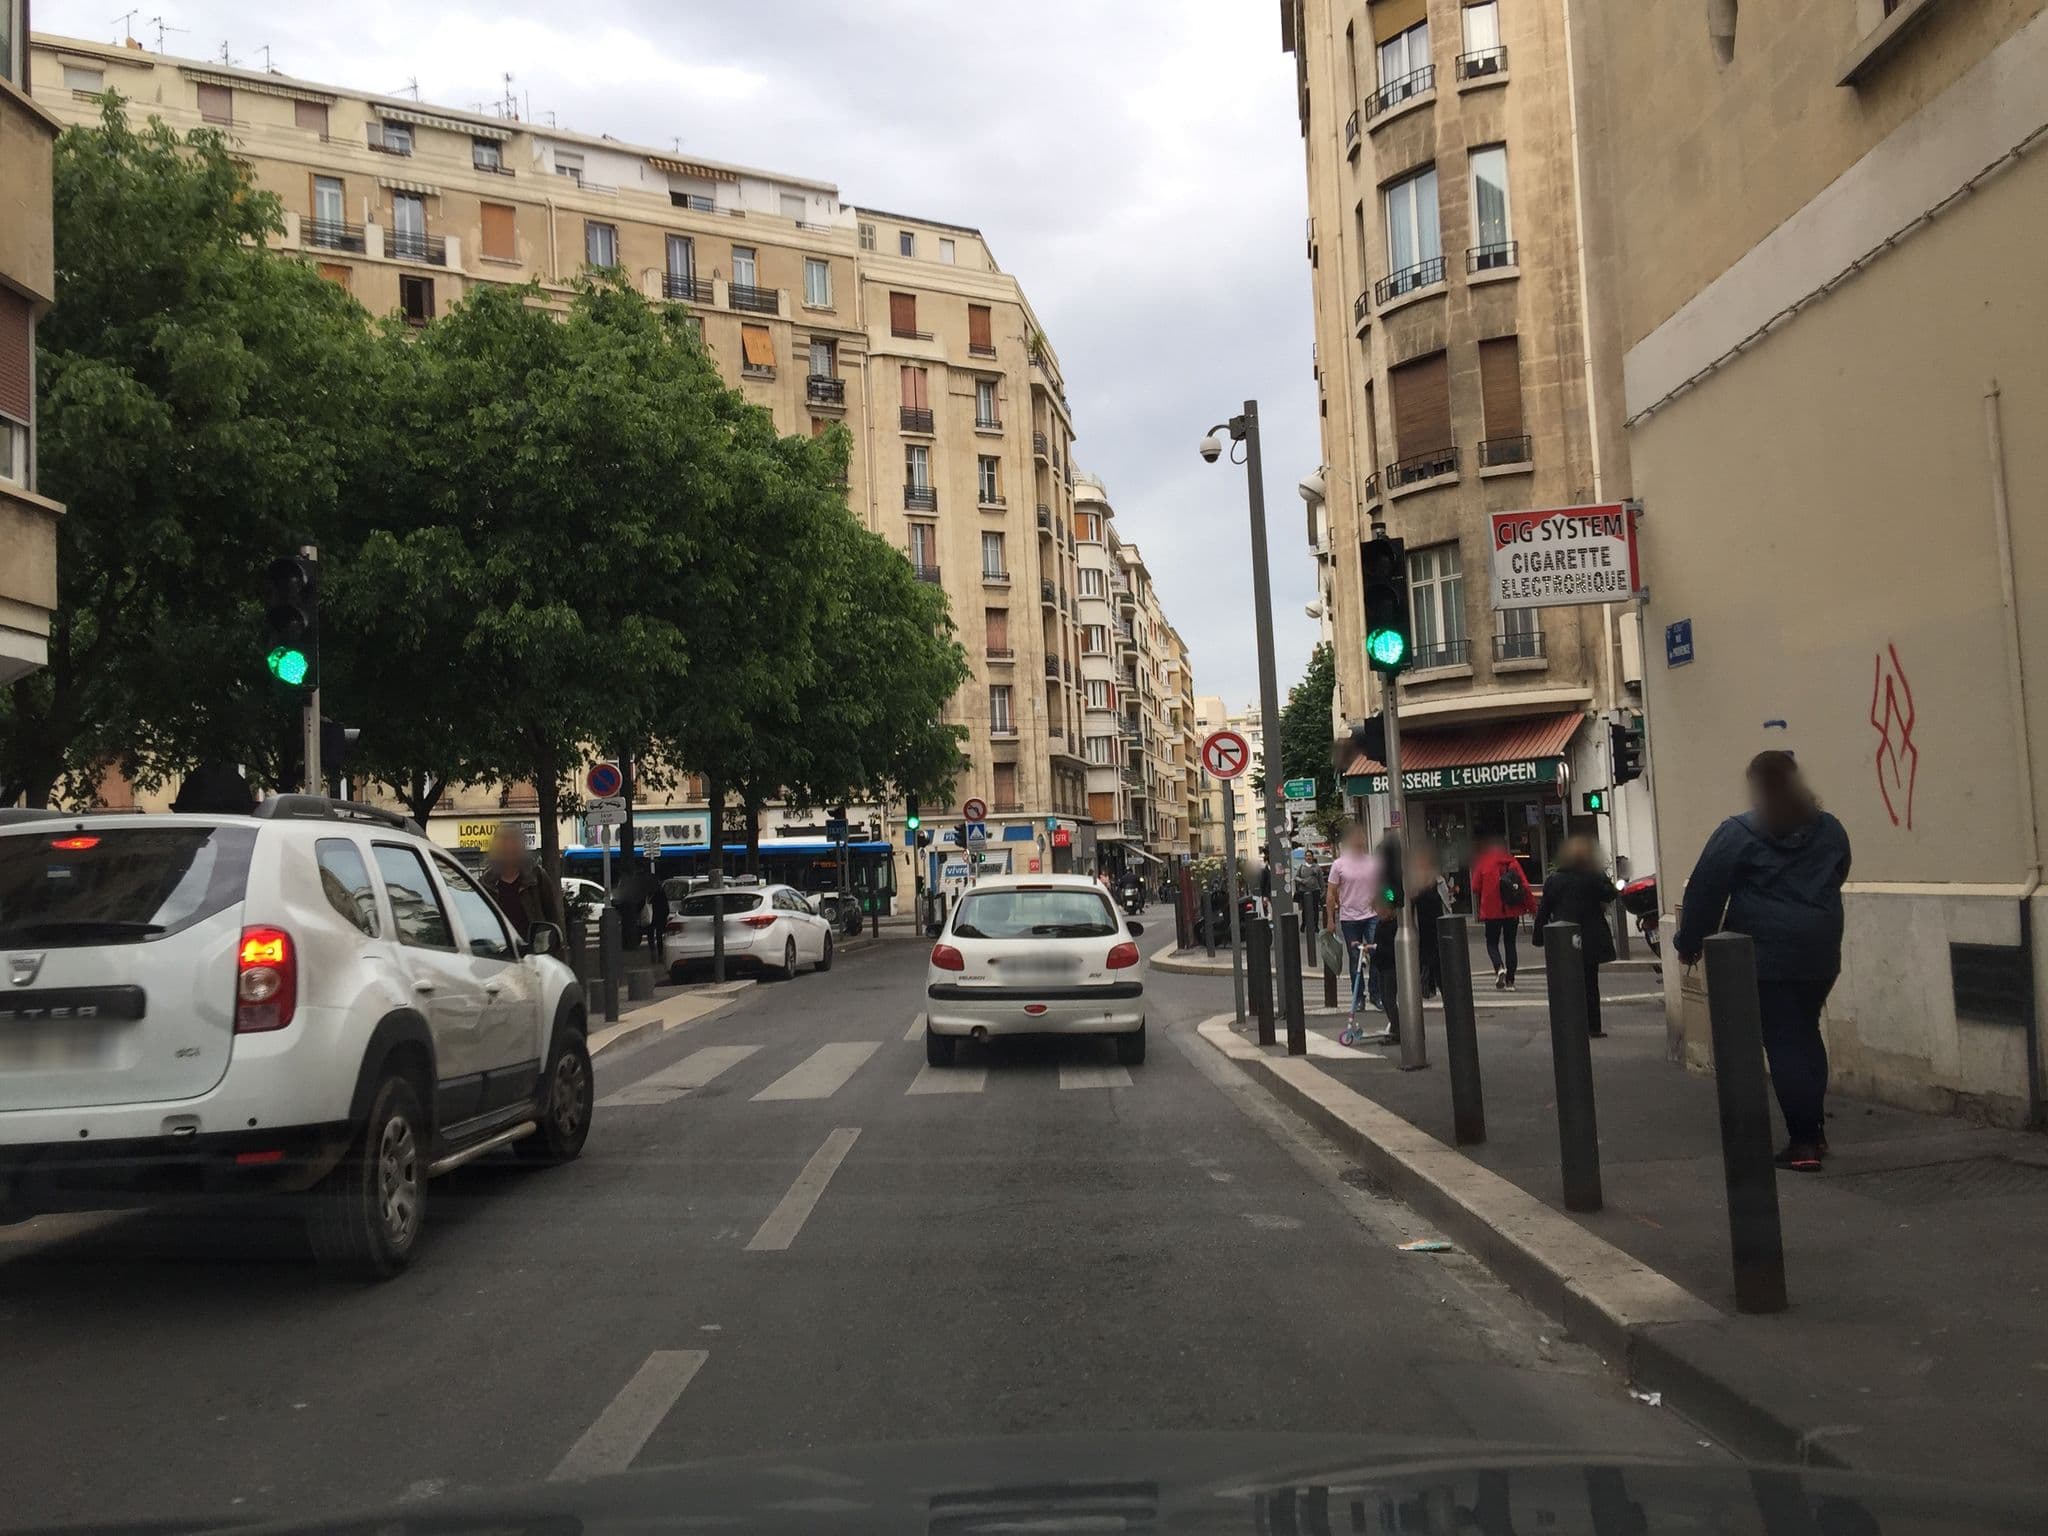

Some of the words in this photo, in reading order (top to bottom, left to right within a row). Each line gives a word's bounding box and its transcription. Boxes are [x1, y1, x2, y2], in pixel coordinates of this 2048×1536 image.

[1498, 520, 1534, 545] CIG
[1541, 514, 1623, 541] SYSTEM
[1512, 546, 1612, 574] CIGARETTE
[1502, 569, 1627, 600] ELECTRONIQUE
[1372, 771, 1442, 792] BRSERIE
